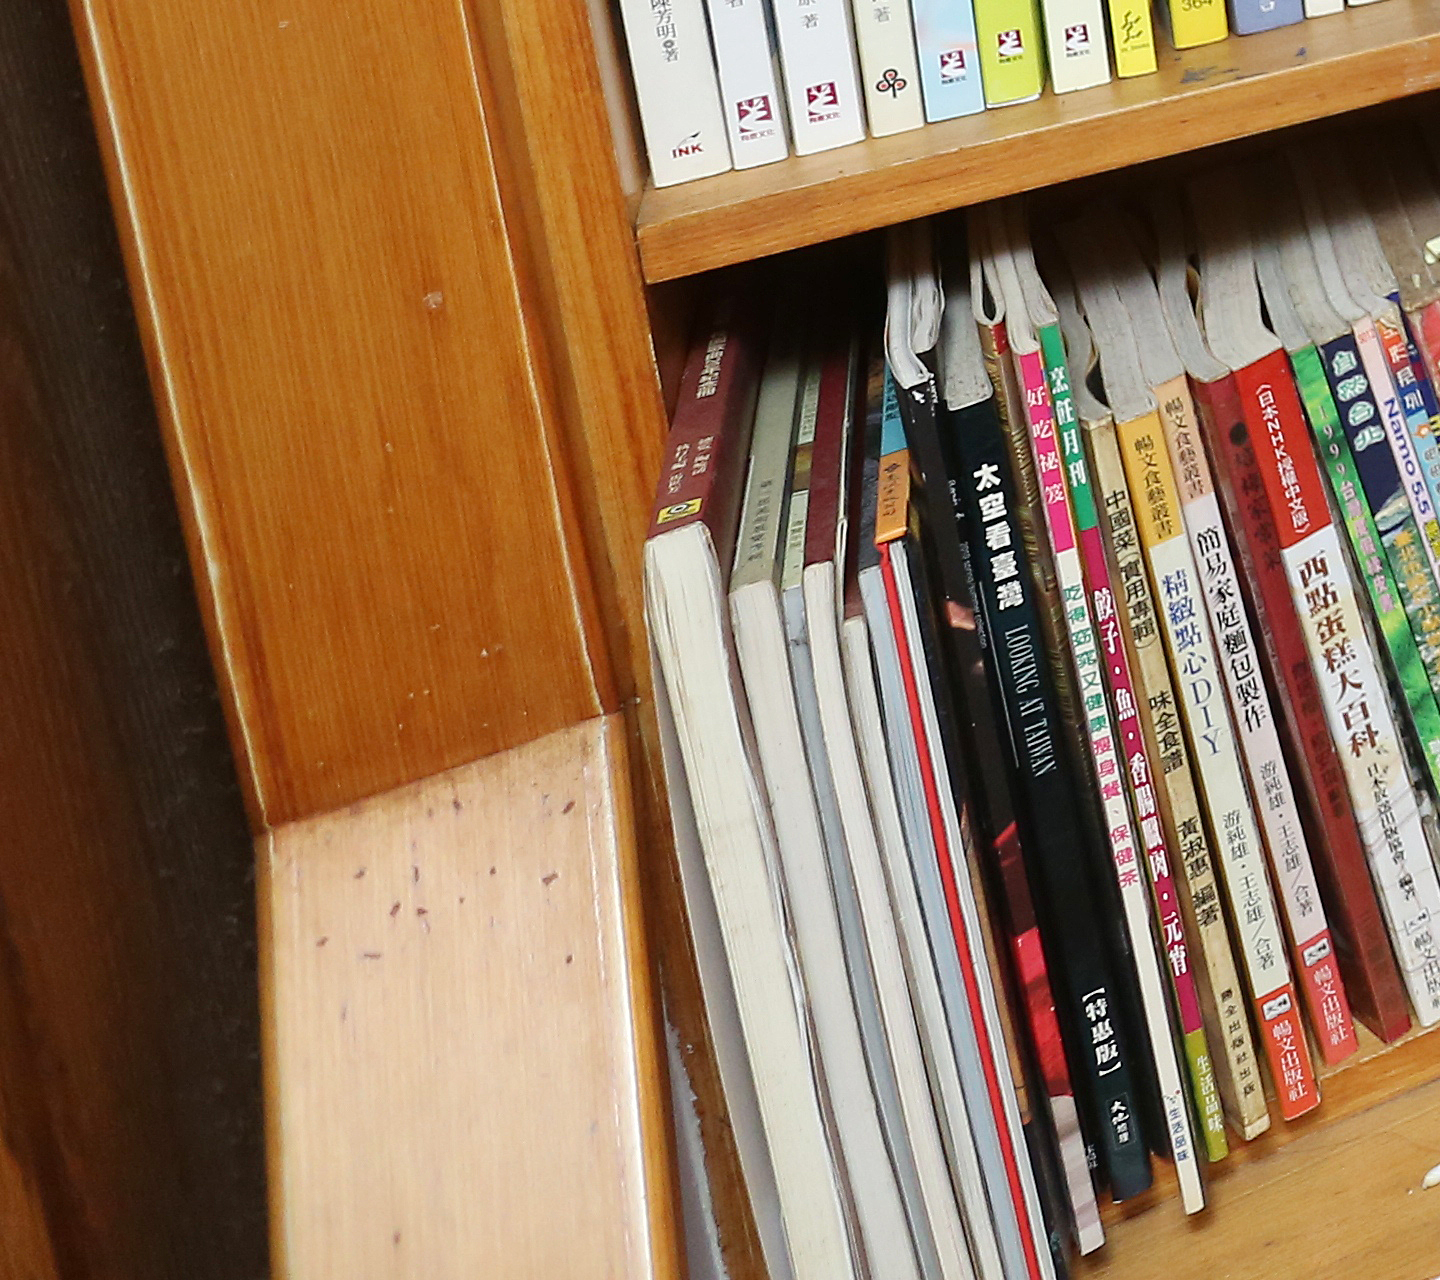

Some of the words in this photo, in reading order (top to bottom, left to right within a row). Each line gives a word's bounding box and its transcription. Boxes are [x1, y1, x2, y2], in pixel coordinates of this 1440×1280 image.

[1048, 366, 1088, 487] 烹飪月刊
[1382, 396, 1416, 478] Namo
[1408, 480, 1430, 515] 5.5
[973, 461, 1026, 610] 太空看臺灣
[1131, 433, 1175, 544] 暢文食藝叢書
[1160, 569, 1223, 757] 精緻點心DIY
[1003, 622, 1034, 695] LOOKING
[1196, 529, 1270, 734] 簡易家庭麵包製作
[1299, 547, 1385, 760] 西點蛋糕大百科
[1019, 697, 1035, 721] AT
[1023, 721, 1058, 779] TAIWAN
[1271, 1021, 1310, 1102] 暢文出版社
[1312, 964, 1352, 1047] 暢文出版社
